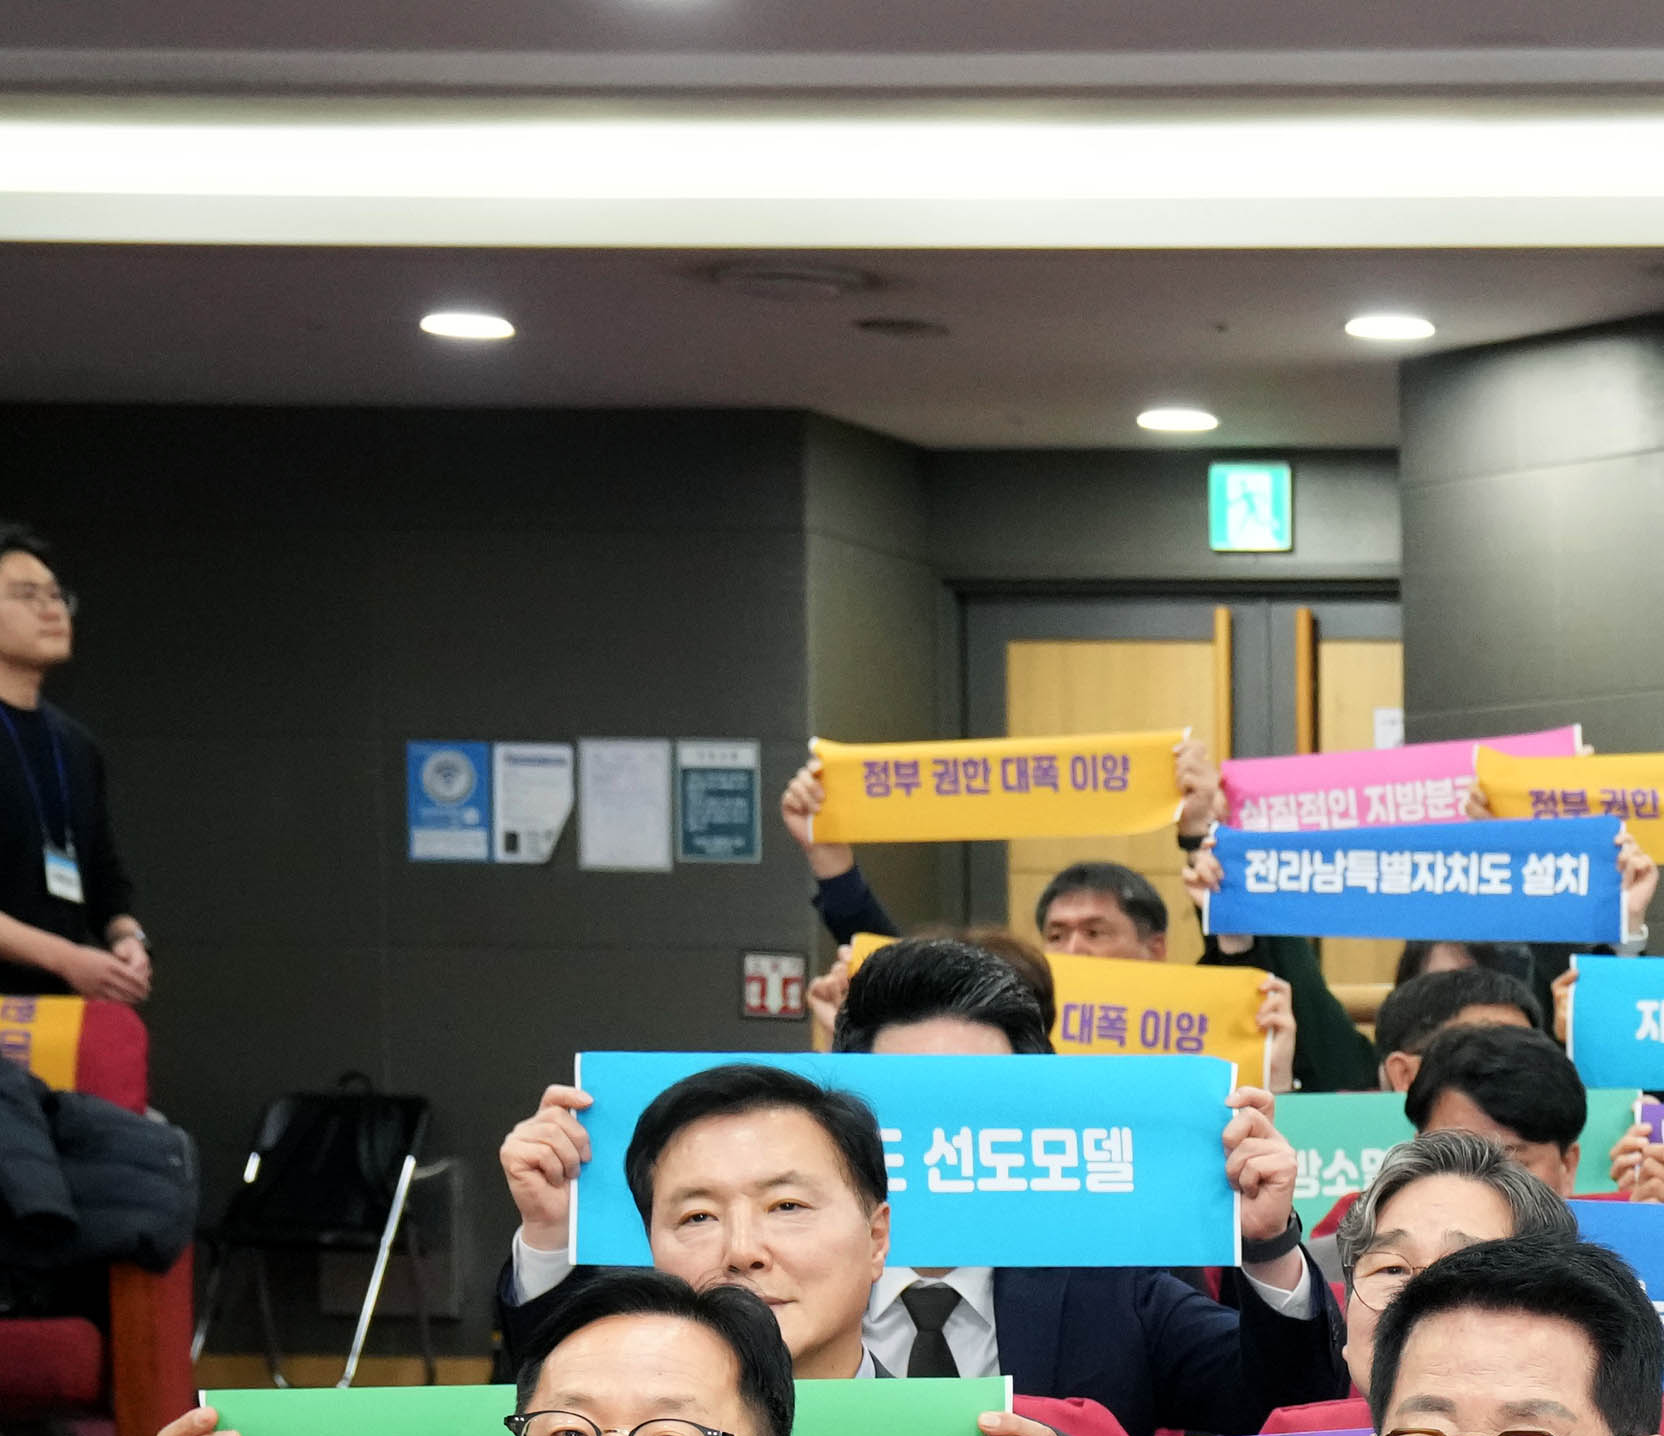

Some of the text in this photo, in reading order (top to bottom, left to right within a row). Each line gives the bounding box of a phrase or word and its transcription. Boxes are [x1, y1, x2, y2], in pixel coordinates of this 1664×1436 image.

[863, 754, 1129, 797] 정부 권한 대폭 이양
[1529, 789, 1590, 819] 정부
[1600, 788, 1660, 820] 권한
[1245, 849, 1588, 896] 전라남특별자치도 설치
[1061, 1003, 1208, 1054] 대폭 이양
[924, 1128, 1133, 1192] 선도모델
